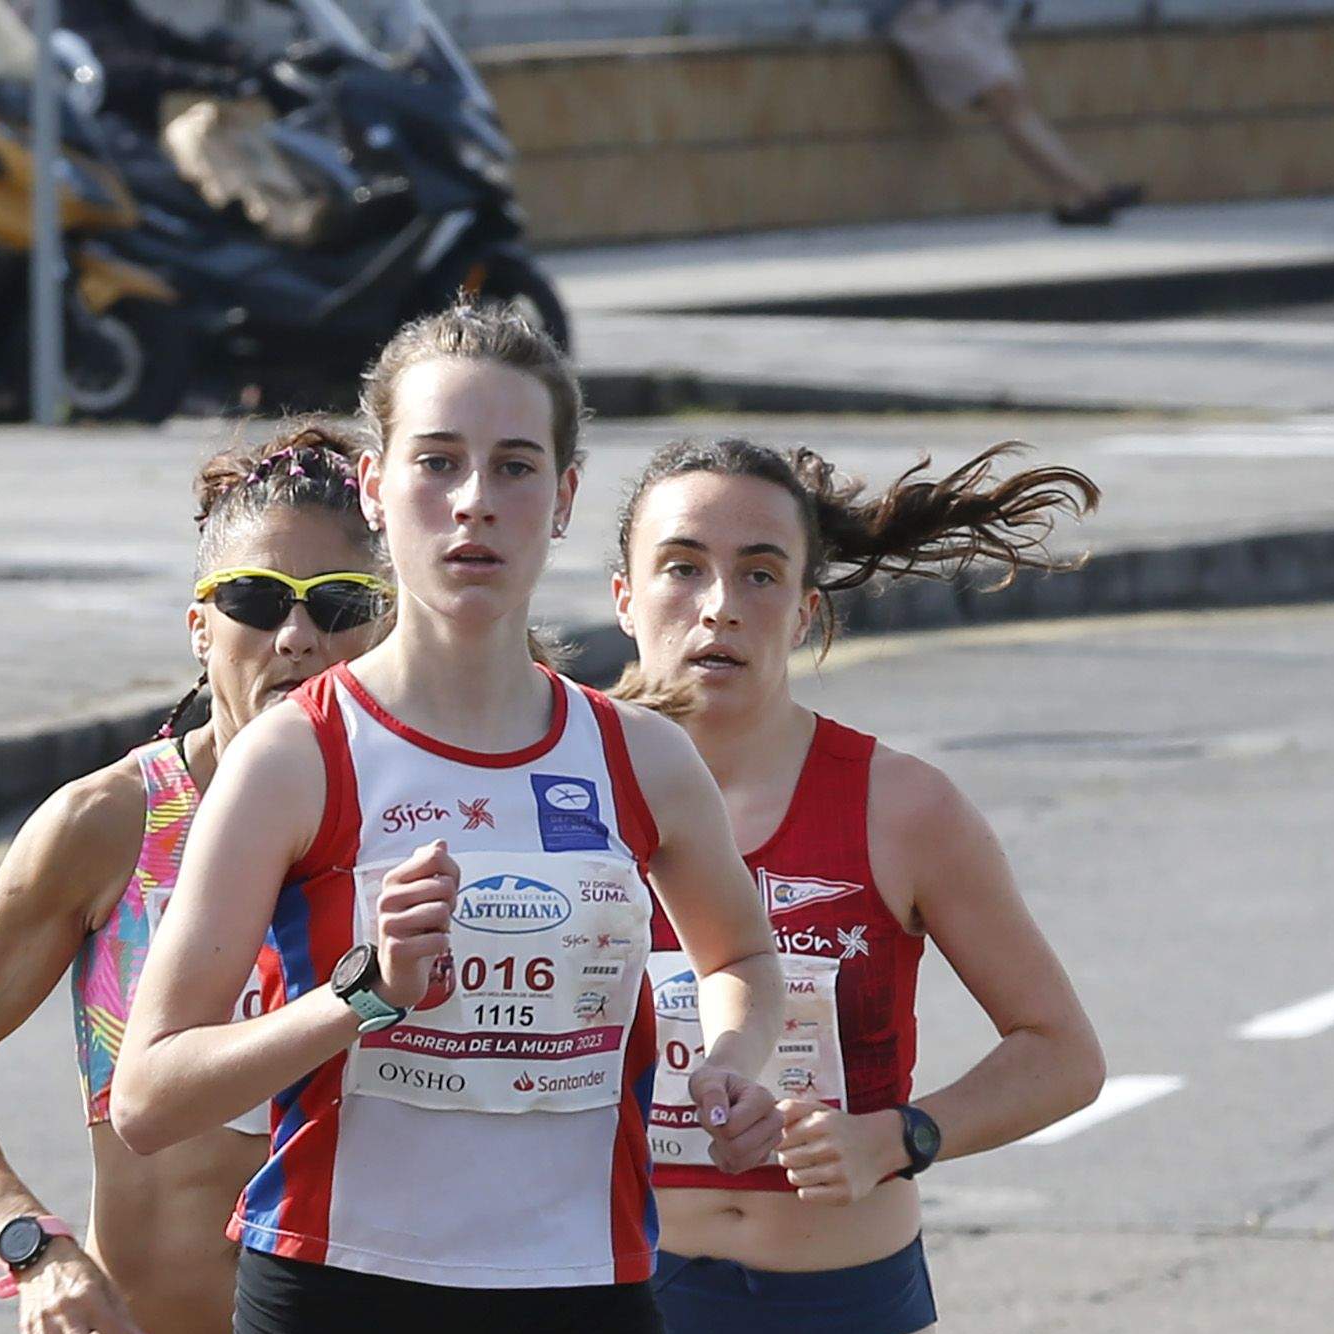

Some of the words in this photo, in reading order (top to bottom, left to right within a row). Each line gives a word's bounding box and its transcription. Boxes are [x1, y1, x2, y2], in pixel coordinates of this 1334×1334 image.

[382, 800, 451, 833] gijón
[459, 896, 563, 919] ASTURIANA
[581, 889, 632, 904] SUMA
[771, 926, 833, 953] ijón
[461, 956, 556, 992] 016
[474, 1004, 534, 1027] 1115
[390, 1031, 466, 1053] CARRERA
[469, 1038, 492, 1052] DE
[496, 1038, 517, 1053] LA
[520, 1039, 574, 1054] MUJER
[576, 1033, 604, 1050] 2023
[379, 1062, 466, 1093] OYSHO
[538, 1071, 606, 1093] Santander
